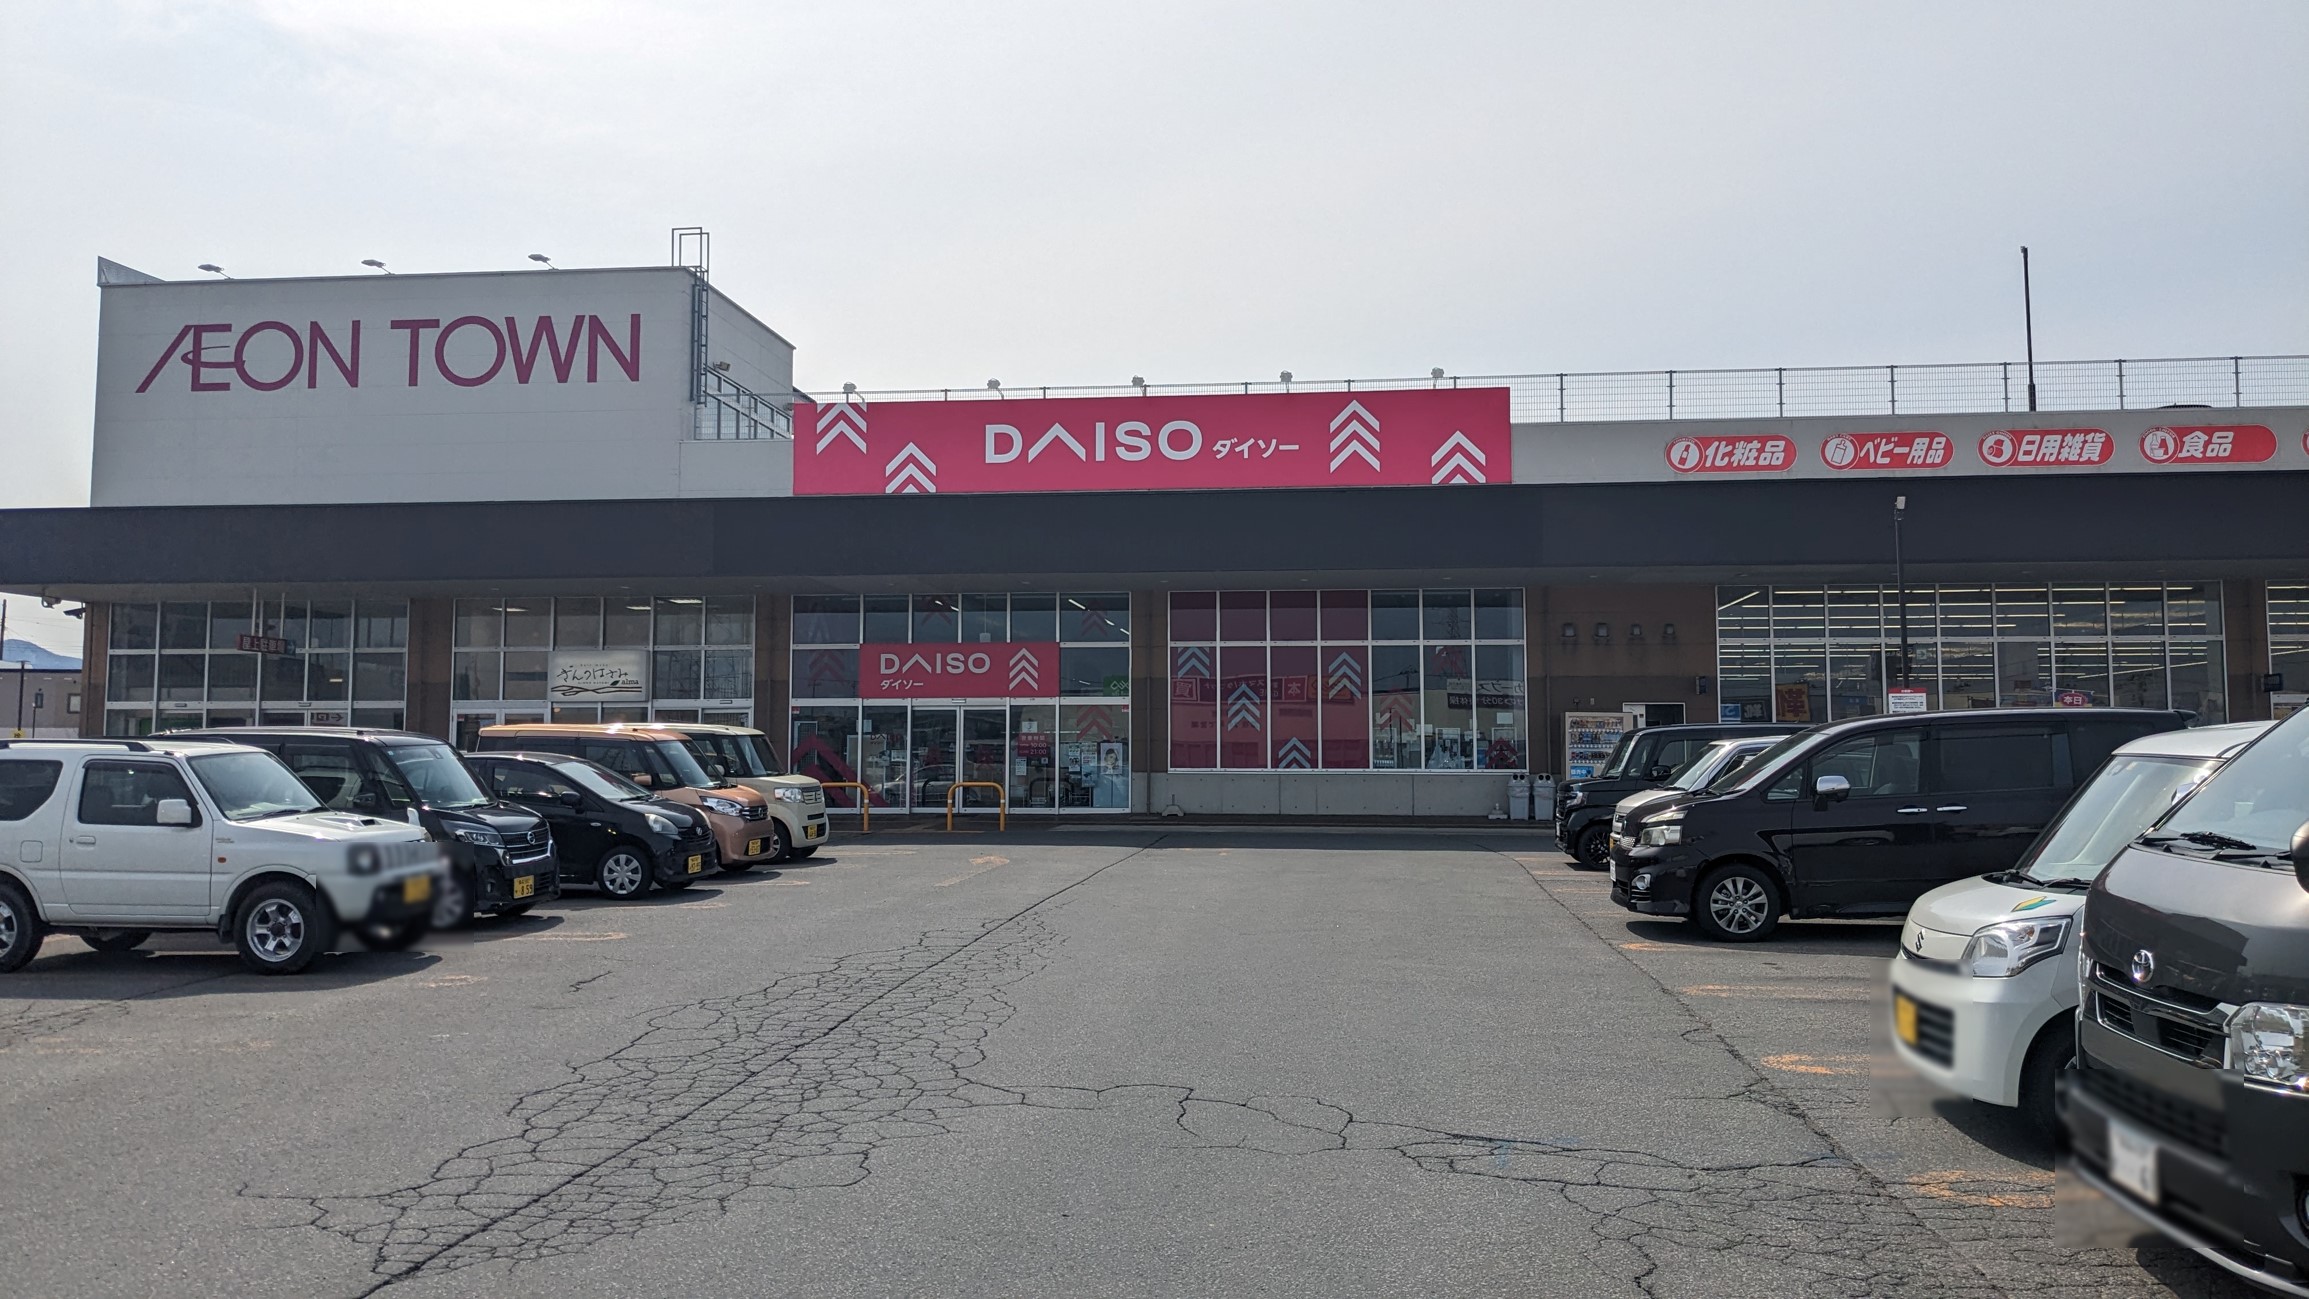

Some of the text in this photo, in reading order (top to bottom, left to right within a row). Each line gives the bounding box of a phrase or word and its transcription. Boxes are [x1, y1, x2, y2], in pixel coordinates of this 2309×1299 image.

[390, 313, 642, 388] TOWN
[984, 420, 1300, 464] DAISO ダイソー
[1705, 440, 1786, 467] 化粧品
[1860, 436, 1947, 465] ベビー用品
[2017, 432, 2106, 462] 日用雑貨
[2178, 430, 2234, 458] 食品
[880, 652, 991, 675] DAISO
[880, 678, 924, 690] ダイソー
